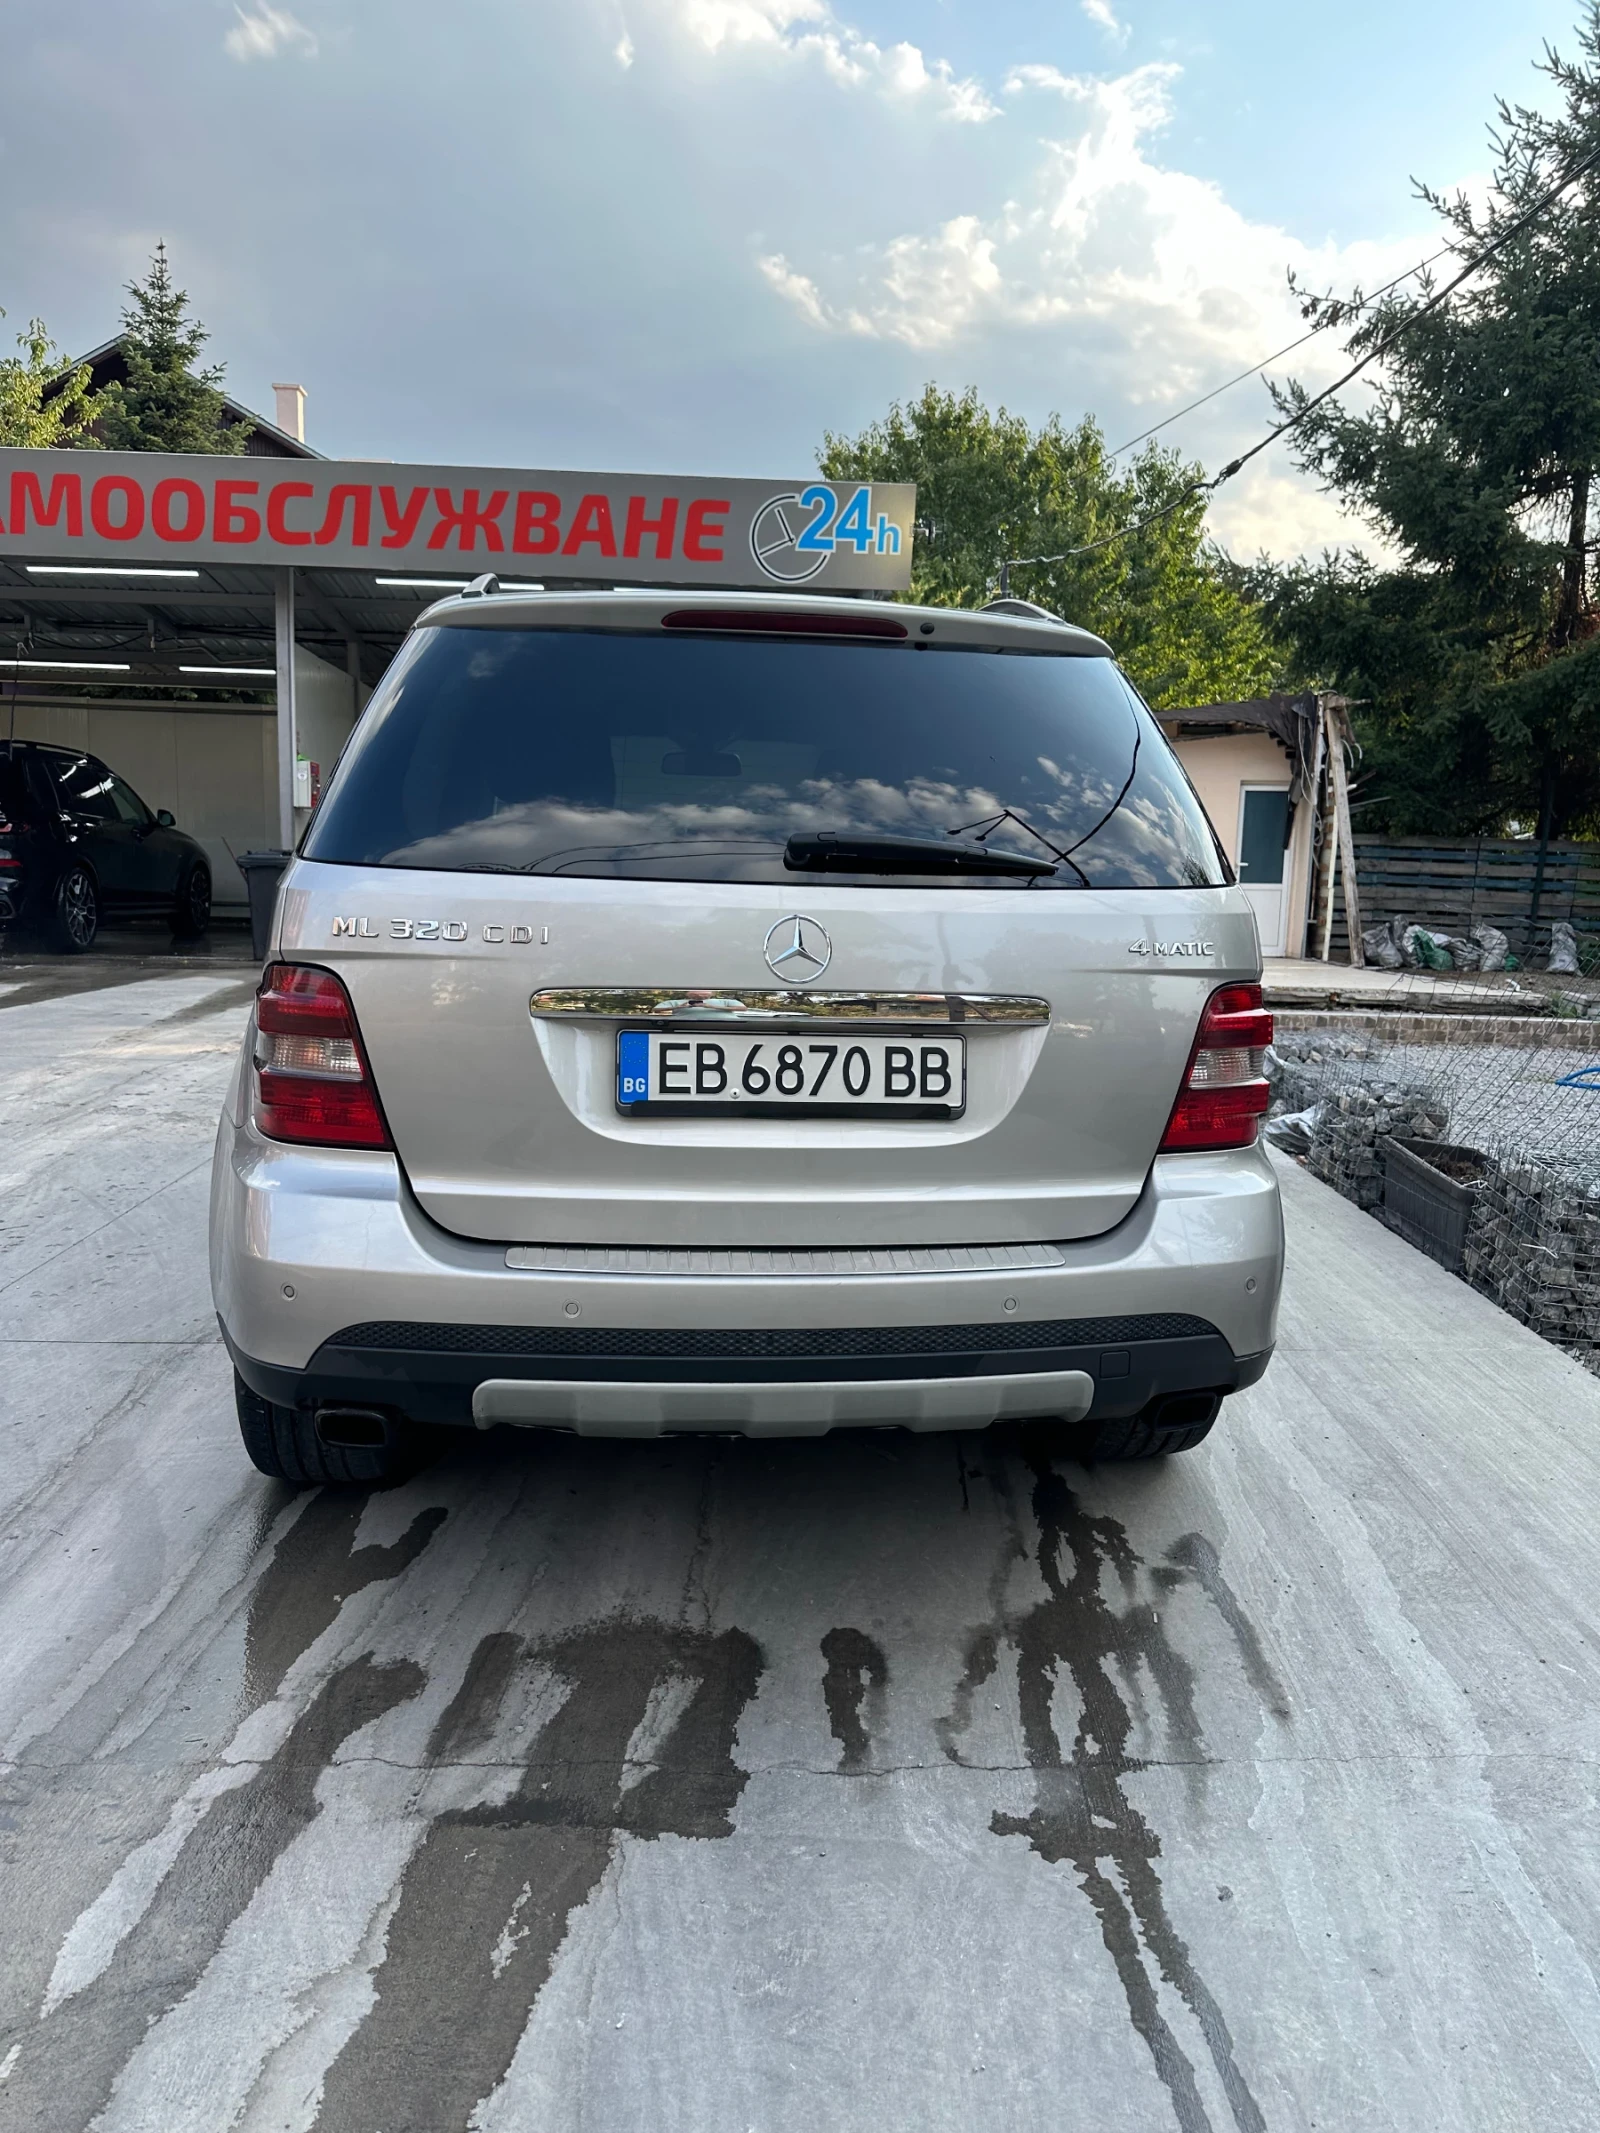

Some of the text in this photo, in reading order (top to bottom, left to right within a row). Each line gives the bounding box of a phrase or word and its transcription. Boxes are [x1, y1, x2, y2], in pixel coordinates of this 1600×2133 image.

[0, 472, 731, 562] МООБСЛУЖВАНЕ
[795, 484, 902, 555] 24h
[332, 916, 549, 944] ML 320 CDI
[623, 1077, 646, 1093] BG
[741, 1044, 871, 1096] 6870
